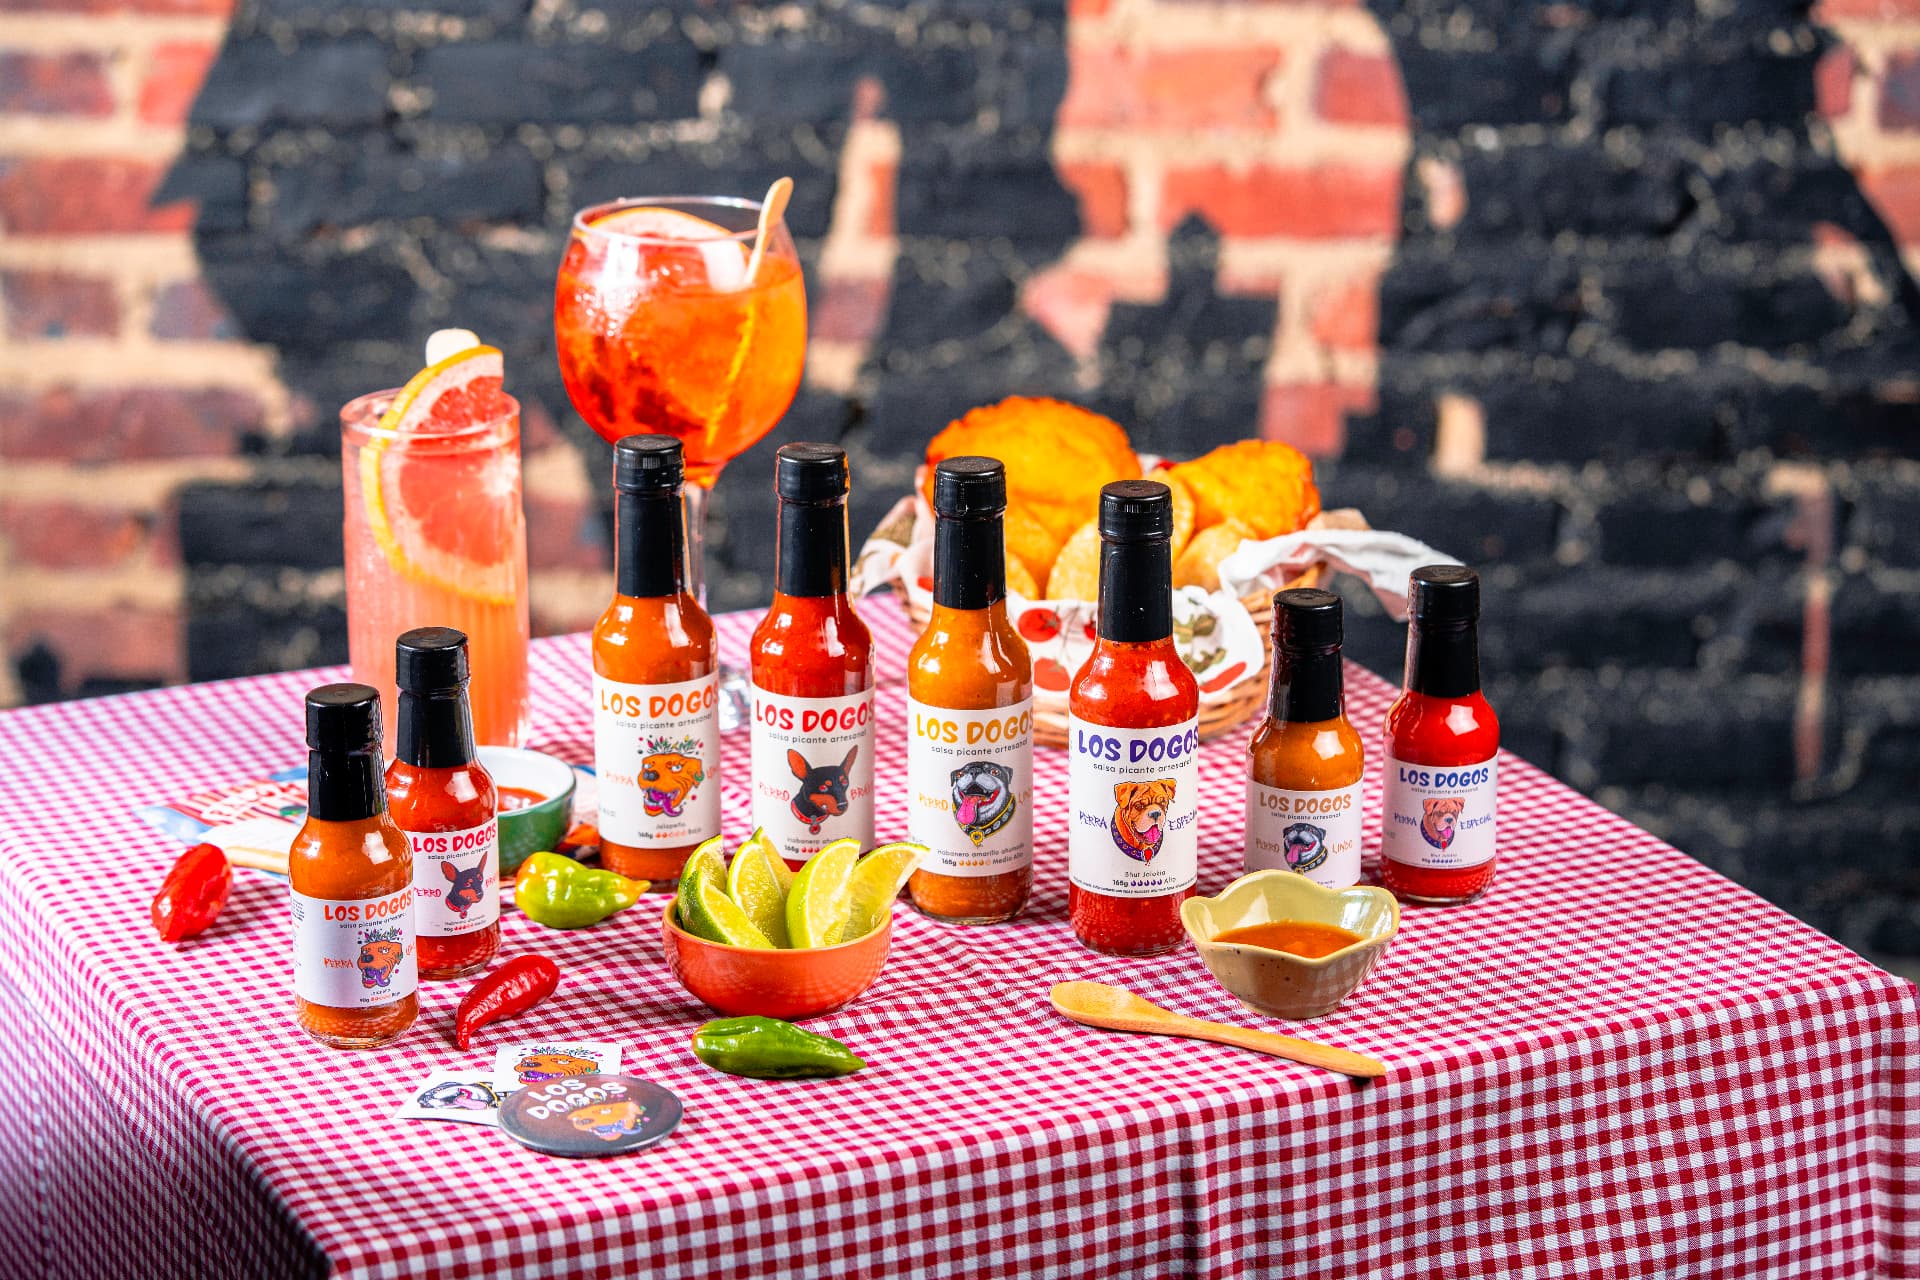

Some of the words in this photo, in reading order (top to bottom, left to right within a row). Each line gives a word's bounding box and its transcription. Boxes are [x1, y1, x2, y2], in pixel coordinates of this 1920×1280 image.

[601, 688, 641, 718] LOS
[649, 681, 718, 718] DOGOS
[640, 721, 675, 731] picante
[678, 712, 713, 727] artesanal
[756, 699, 794, 730] LOS
[802, 698, 873, 733] DOGOS
[768, 731, 789, 742] salsa
[792, 733, 827, 744] picante
[830, 728, 867, 743] artesanal
[916, 713, 958, 743] LOS
[931, 746, 953, 755] salsa
[956, 747, 992, 758] picante
[995, 738, 1028, 754] artesanal
[1078, 729, 1121, 761] LOS
[1129, 725, 1198, 763] DOGOS
[1093, 762, 1116, 773] salsa
[1119, 763, 1155, 775] picante
[1158, 757, 1192, 772] artesanal
[1400, 767, 1430, 787] LOS
[1435, 767, 1489, 788] DOGOS
[1260, 791, 1290, 812] LOS
[1294, 794, 1352, 814] DOGOS
[1079, 810, 1108, 830] PERRA
[1394, 812, 1417, 826] PERRA
[413, 836, 447, 853] LOS
[453, 822, 496, 851] DOGOS
[446, 851, 469, 860] picante
[942, 858, 957, 867] 165g
[1112, 879, 1129, 888] 165g
[323, 905, 360, 922] LOS
[365, 889, 412, 920] DOGOS
[323, 957, 354, 969] PERRA
[528, 1078, 587, 1101] LOS
[526, 1081, 627, 1120] DOGOS
